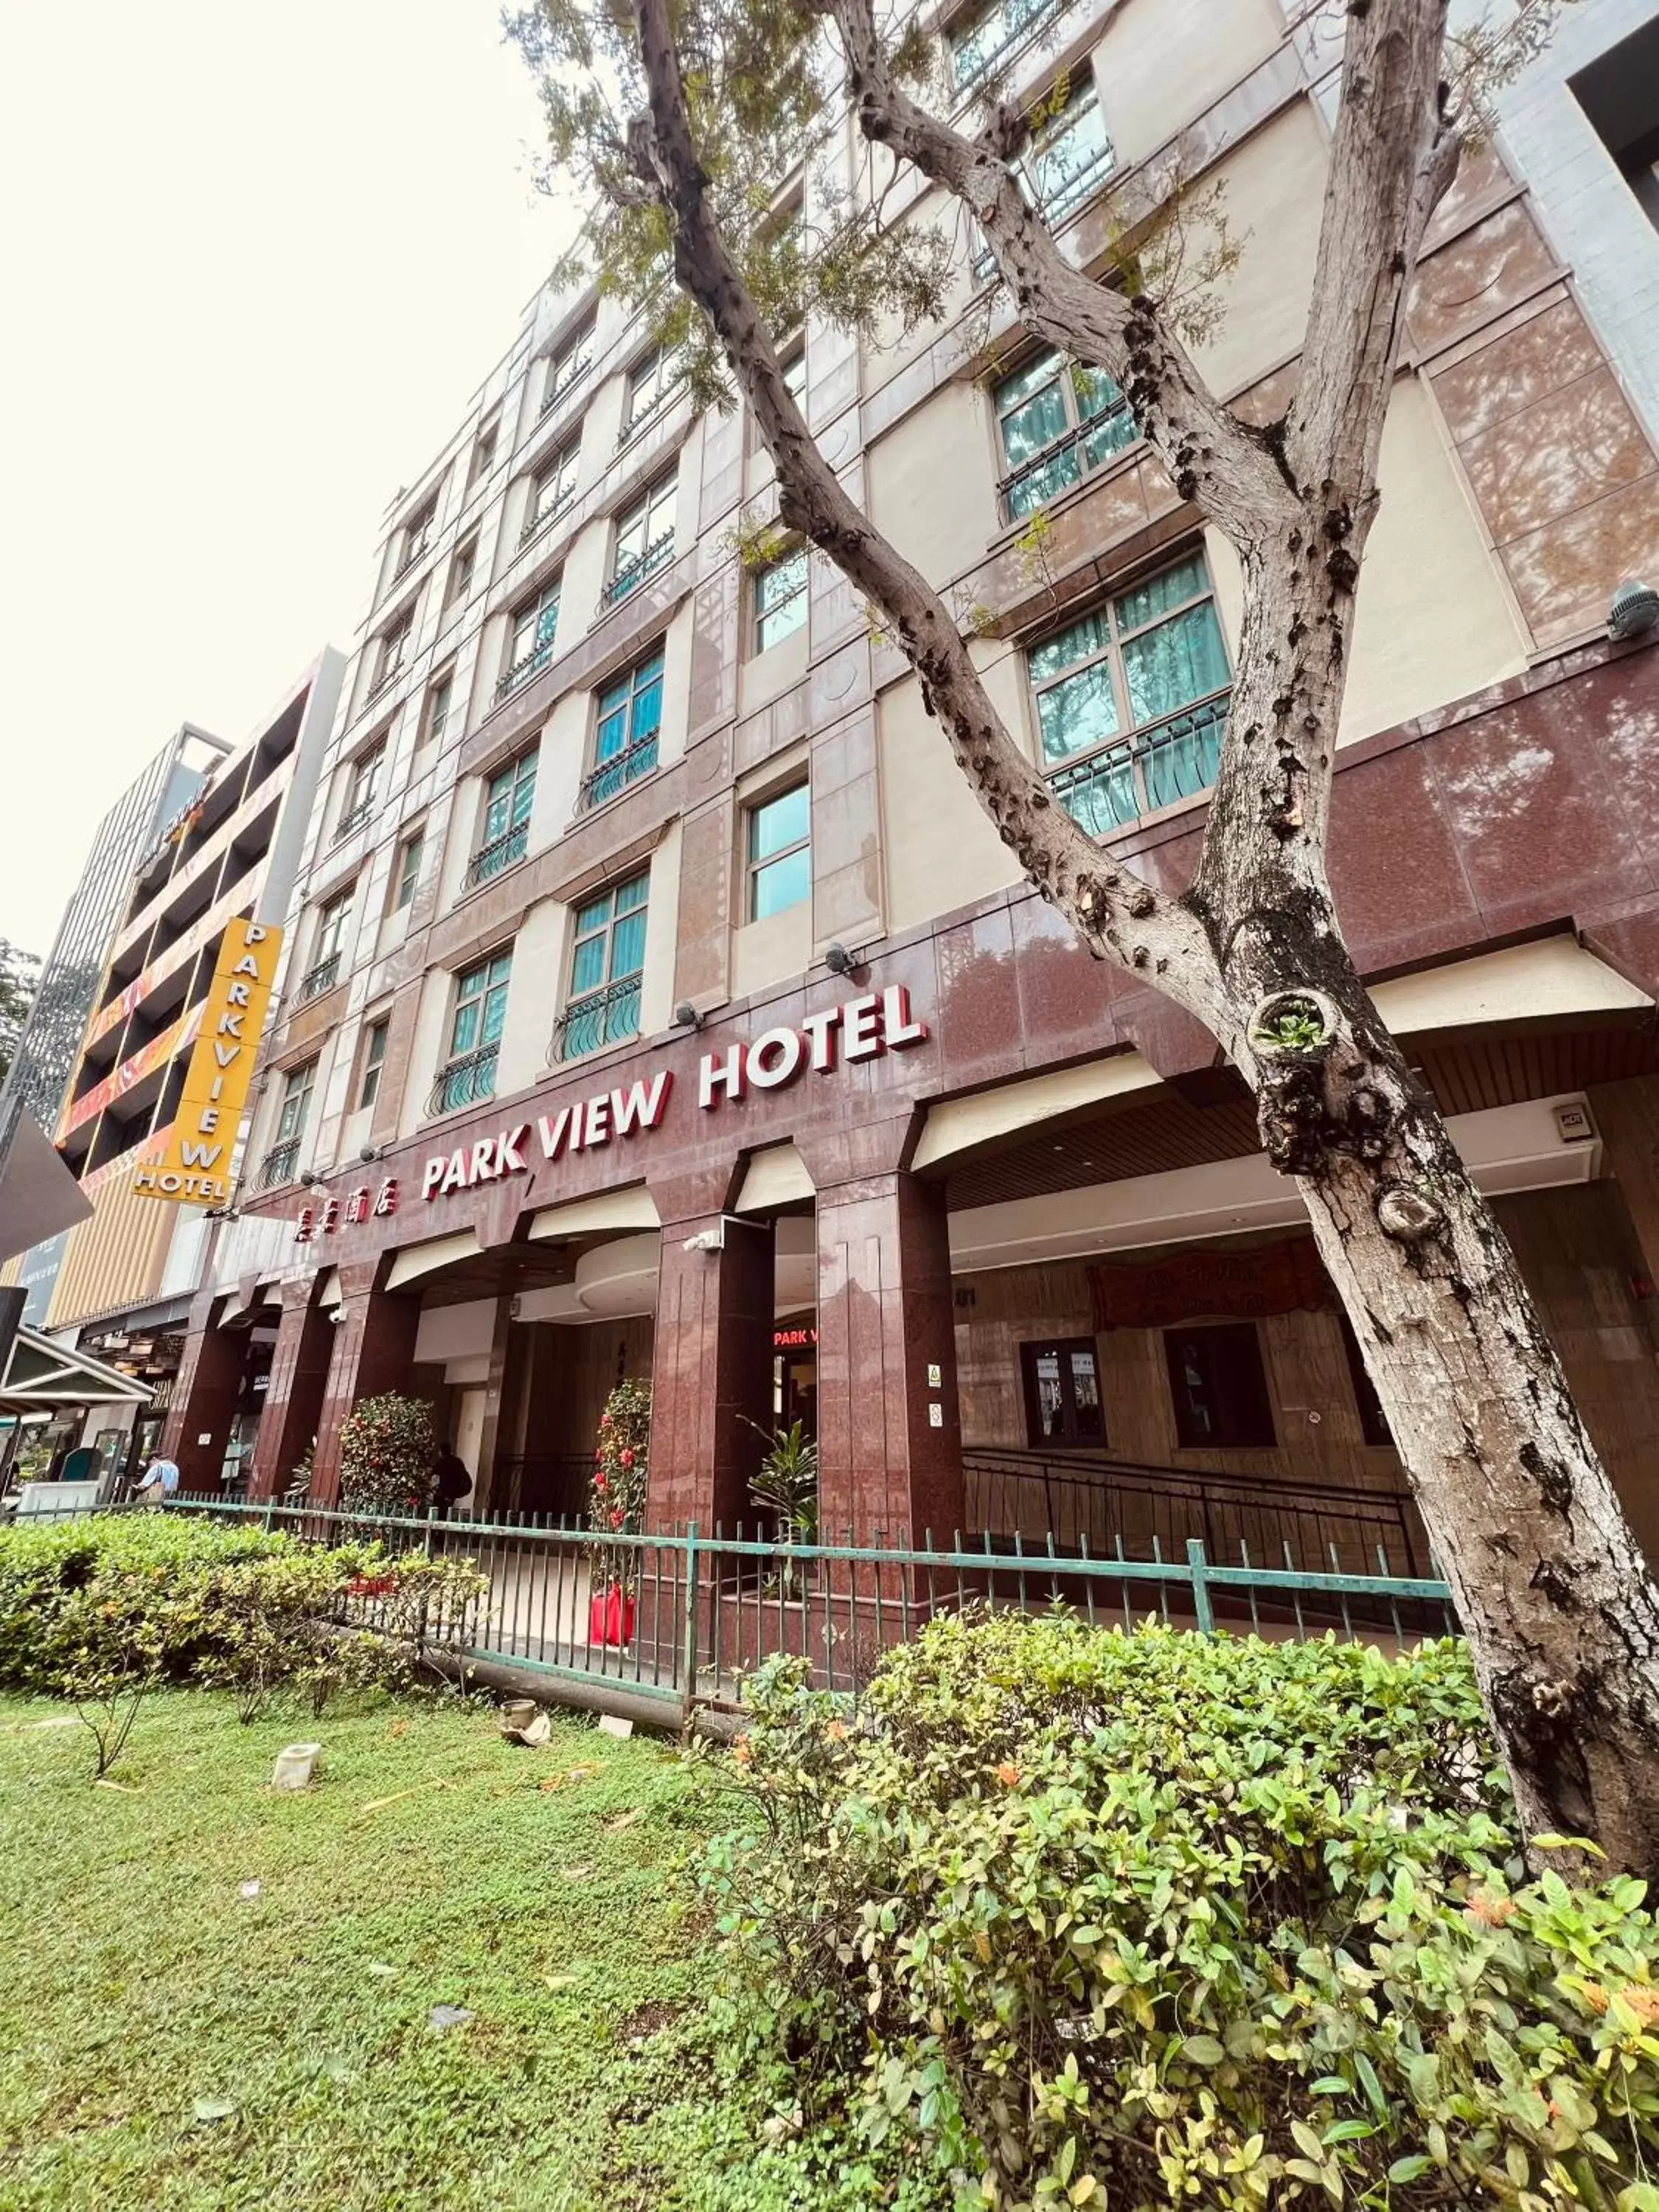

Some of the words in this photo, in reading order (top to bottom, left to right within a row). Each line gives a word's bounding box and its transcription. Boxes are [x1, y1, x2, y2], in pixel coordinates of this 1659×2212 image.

[421, 1124, 532, 1201] PARK
[538, 1070, 675, 1162] VIEW
[698, 984, 928, 1111] HOTEL
[135, 1169, 225, 1198] HOTEL
[773, 1329, 807, 1346] PARK
